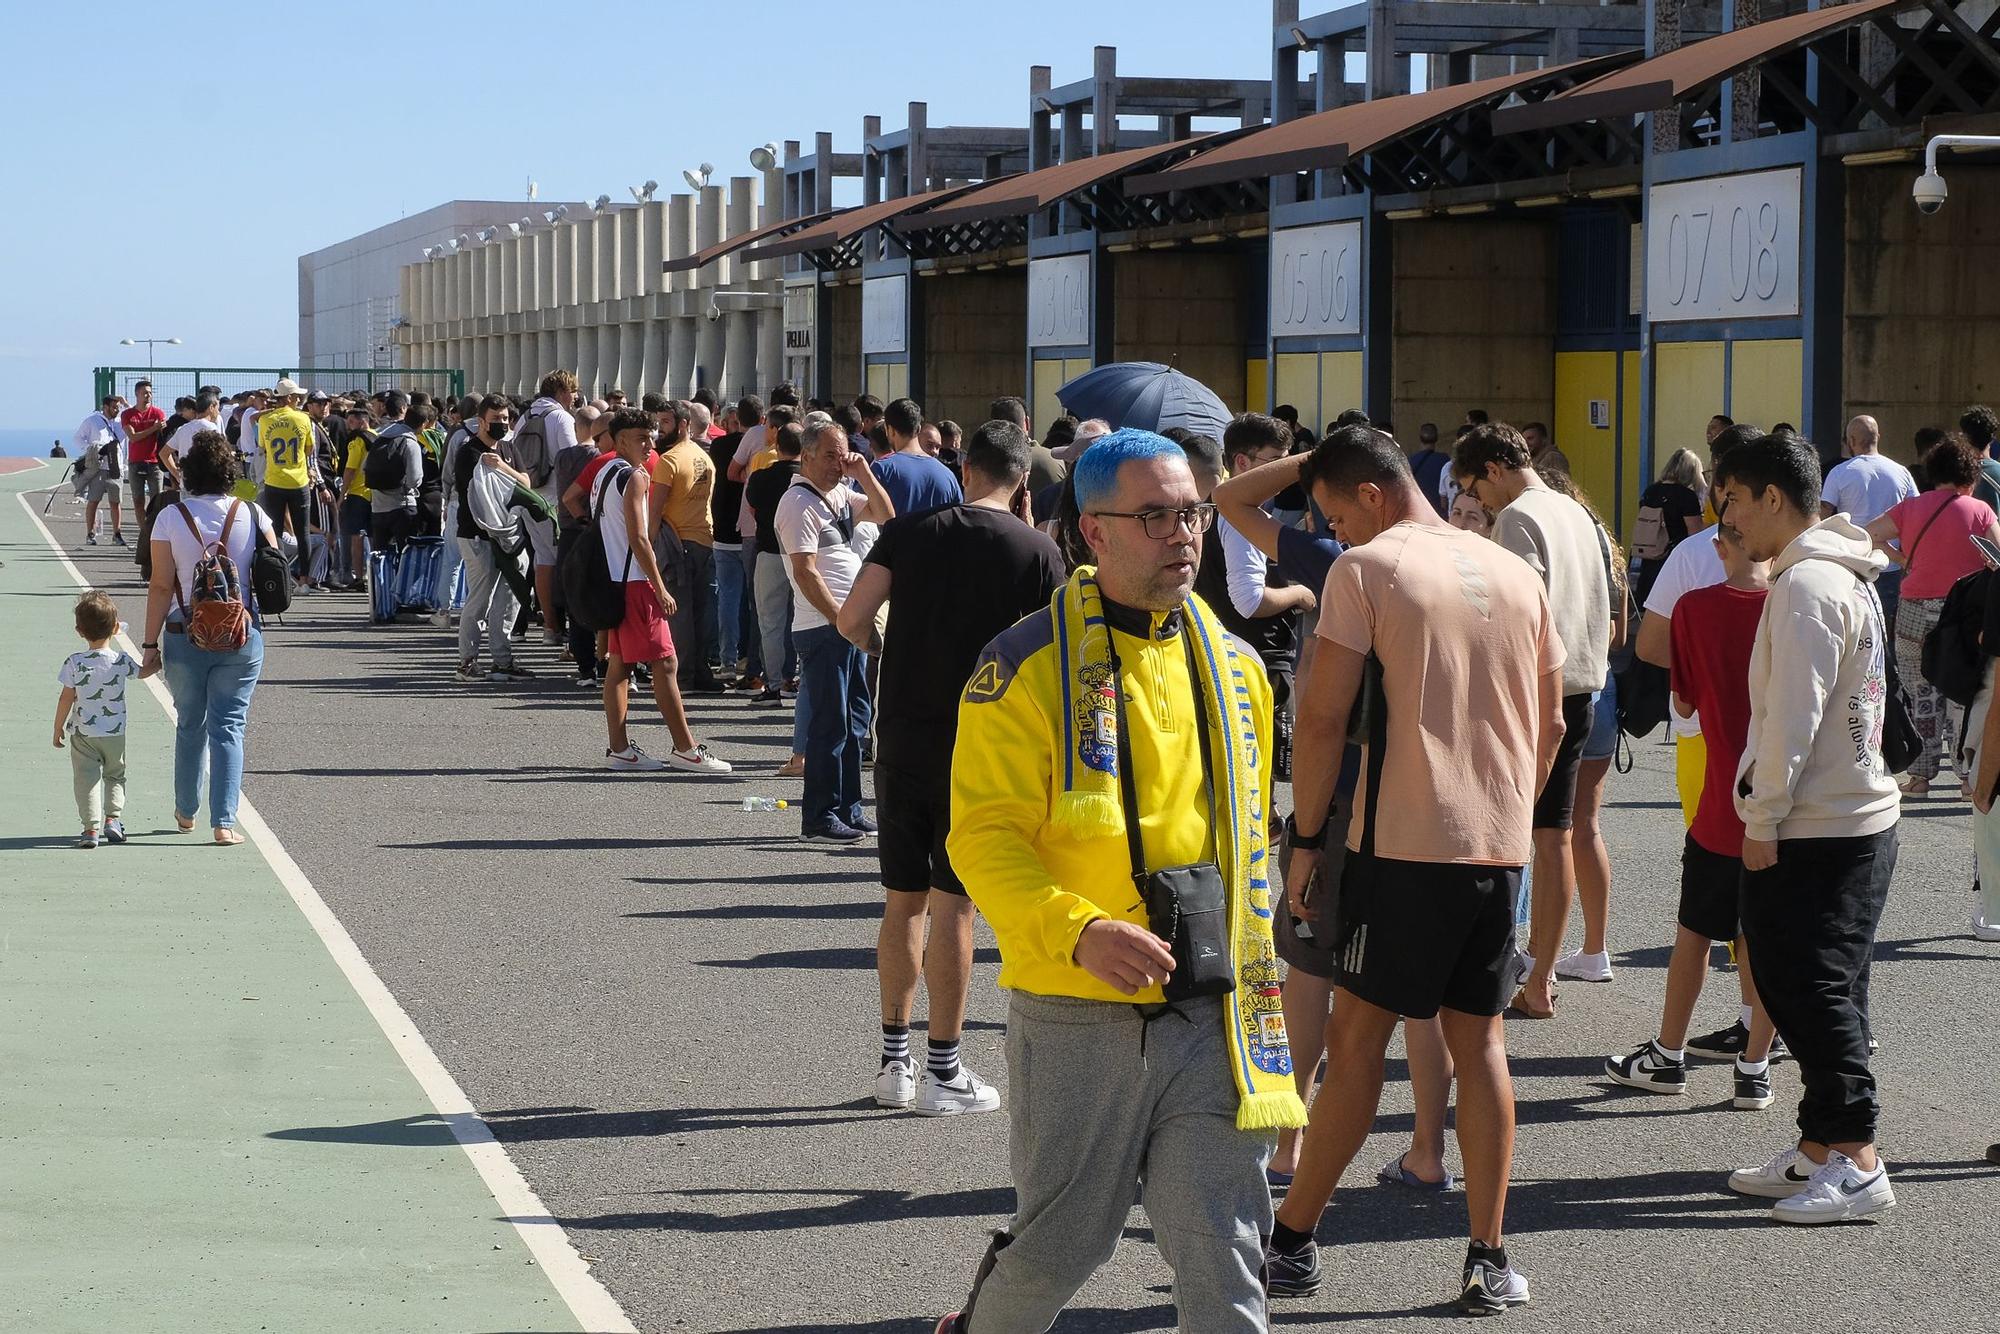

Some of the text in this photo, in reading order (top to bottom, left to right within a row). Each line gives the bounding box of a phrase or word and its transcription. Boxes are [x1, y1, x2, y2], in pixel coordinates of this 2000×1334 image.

[1668, 202, 1780, 307] 07 08
[1281, 246, 1349, 325] 05 06
[271, 437, 299, 465] 21
[1857, 636, 1874, 651] 98
[1848, 716, 1872, 768] always
